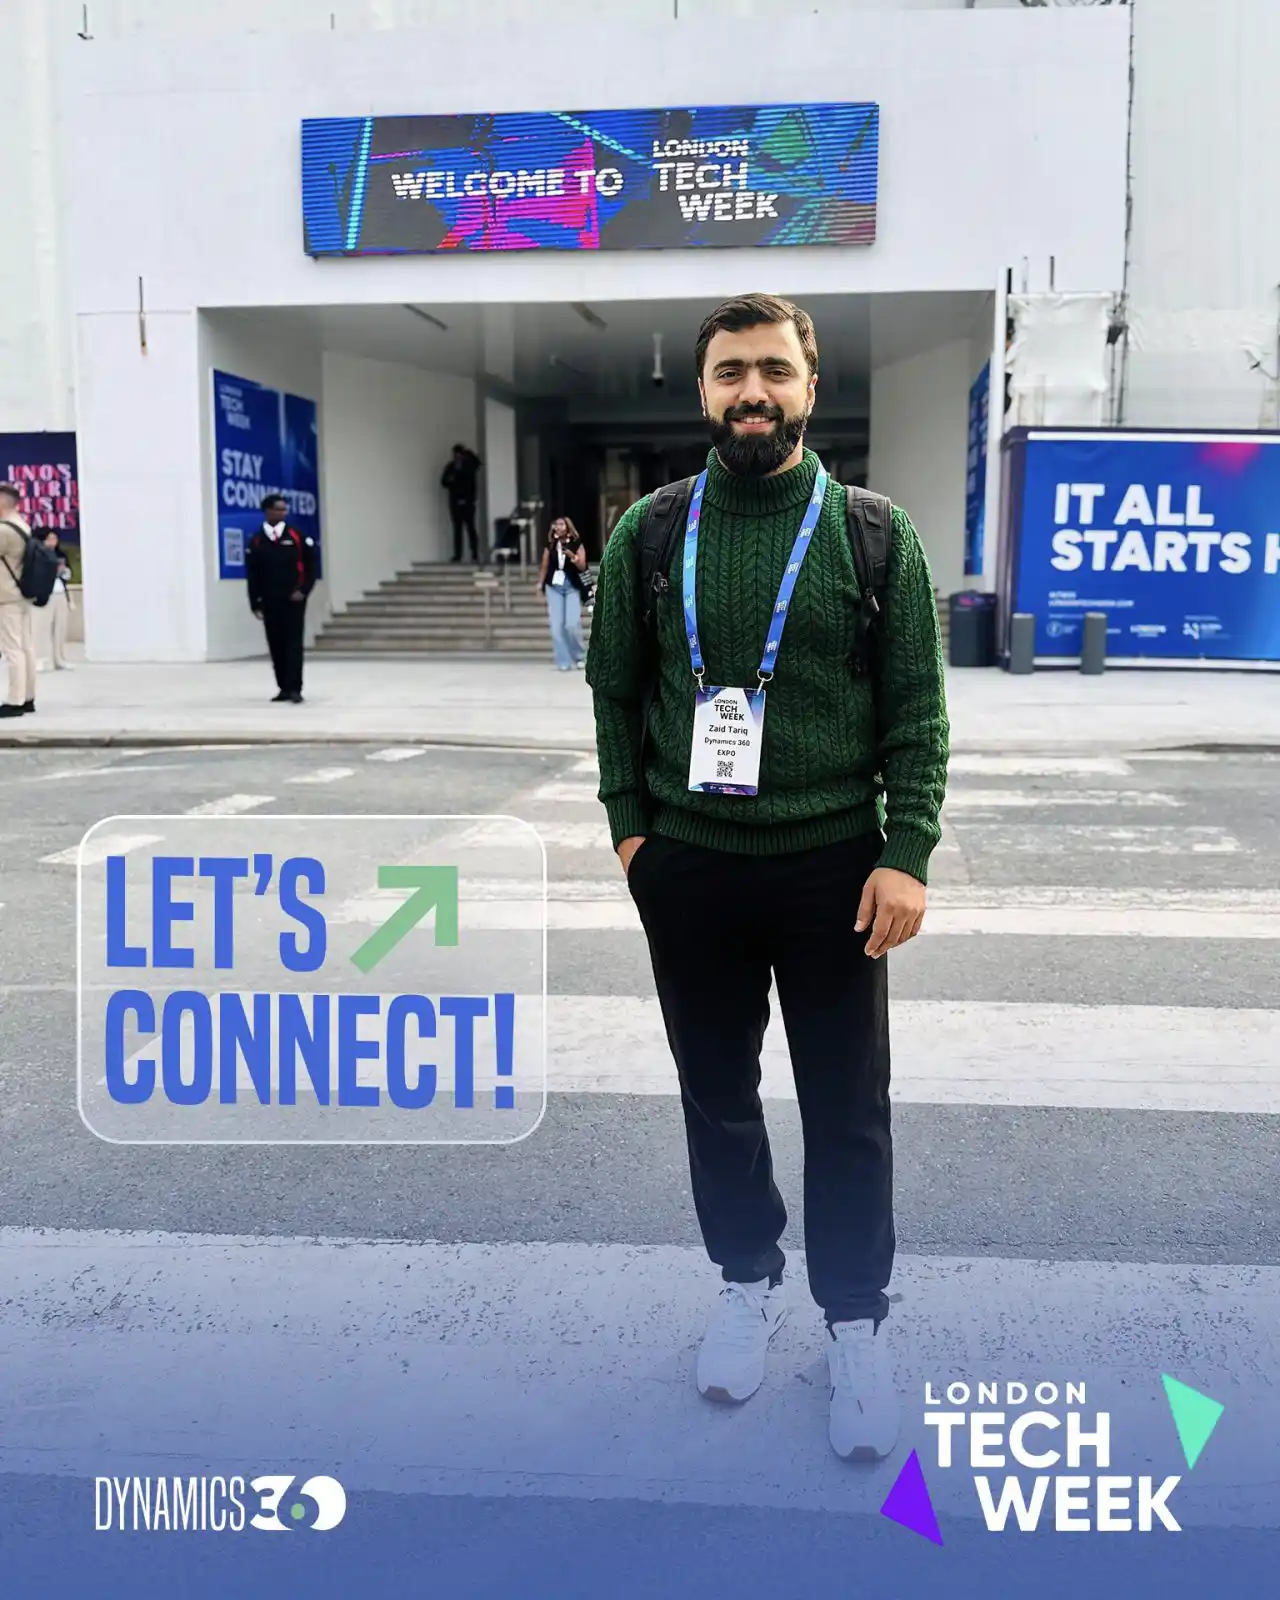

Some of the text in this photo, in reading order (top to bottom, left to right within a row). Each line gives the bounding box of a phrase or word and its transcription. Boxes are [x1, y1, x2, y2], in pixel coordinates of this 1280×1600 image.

[653, 139, 748, 158] LONDON
[391, 168, 624, 199] WELCOME TO
[652, 162, 748, 191] TECH
[678, 192, 778, 221] WEEK
[222, 448, 264, 481] STAY
[1054, 483, 1215, 526] IT ALL
[1050, 529, 1252, 574] STARTS
[714, 704, 738, 712] TECH
[720, 712, 745, 721] WEEK
[704, 737, 751, 747] Dynamics 360
[709, 724, 748, 736] Zaid Tariq
[717, 749, 736, 757] EXPO
